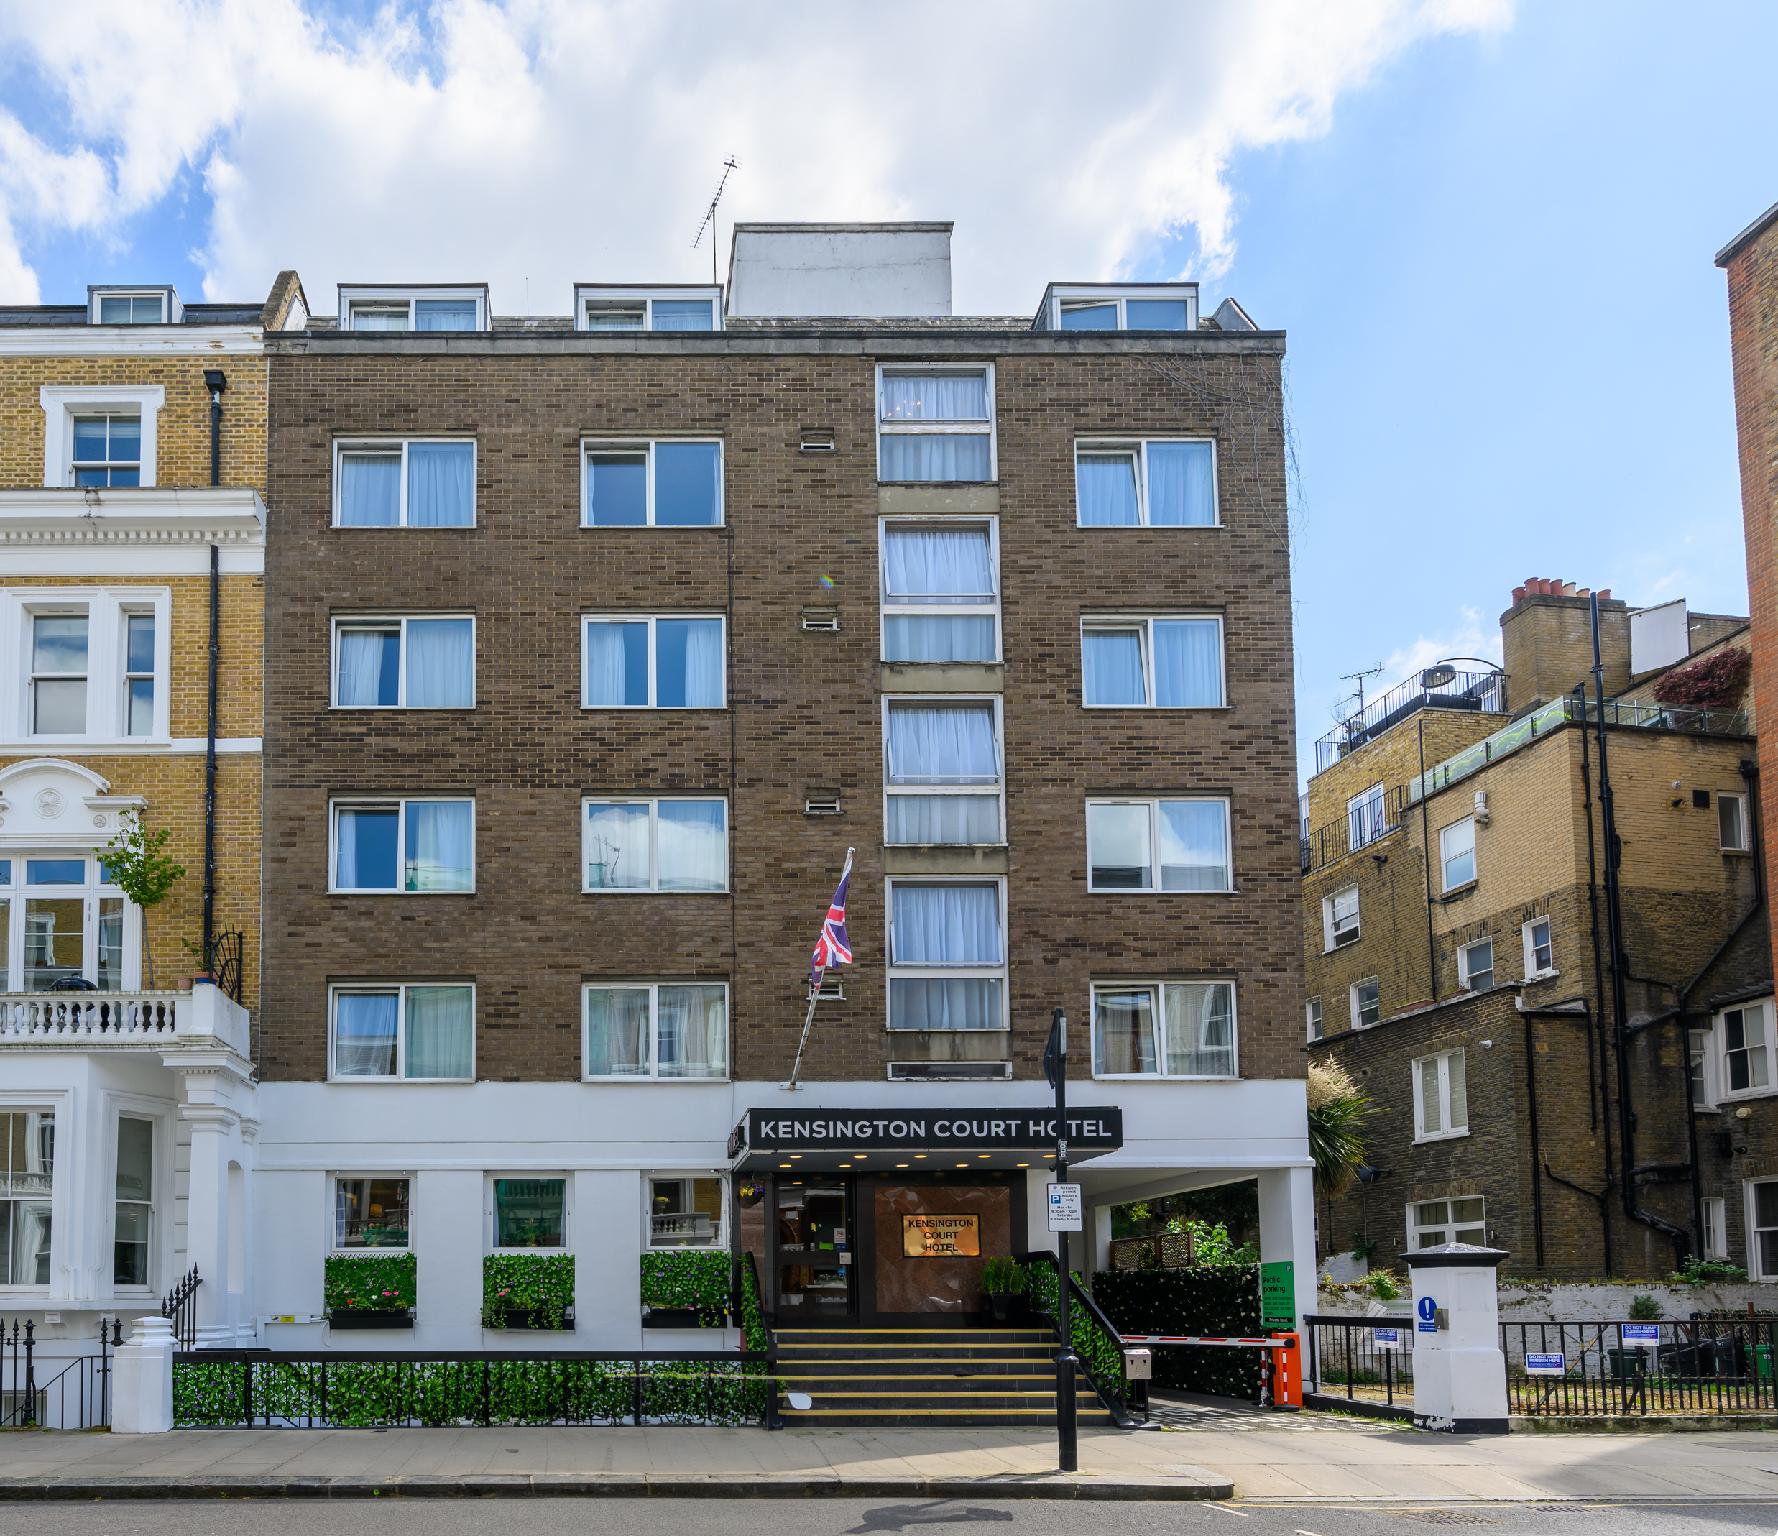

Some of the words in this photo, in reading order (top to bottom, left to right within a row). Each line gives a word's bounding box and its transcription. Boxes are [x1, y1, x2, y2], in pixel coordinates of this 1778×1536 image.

[760, 1120, 926, 1138] KENSINGTON
[933, 1120, 1021, 1137] COURT
[1029, 1120, 1112, 1137] HOTEL
[1052, 1195, 1060, 1204] P
[908, 1219, 974, 1228] KENSINGTON
[923, 1231, 959, 1240] COURT
[925, 1243, 959, 1252] HOTEL
[1263, 1284, 1286, 1294] parking
